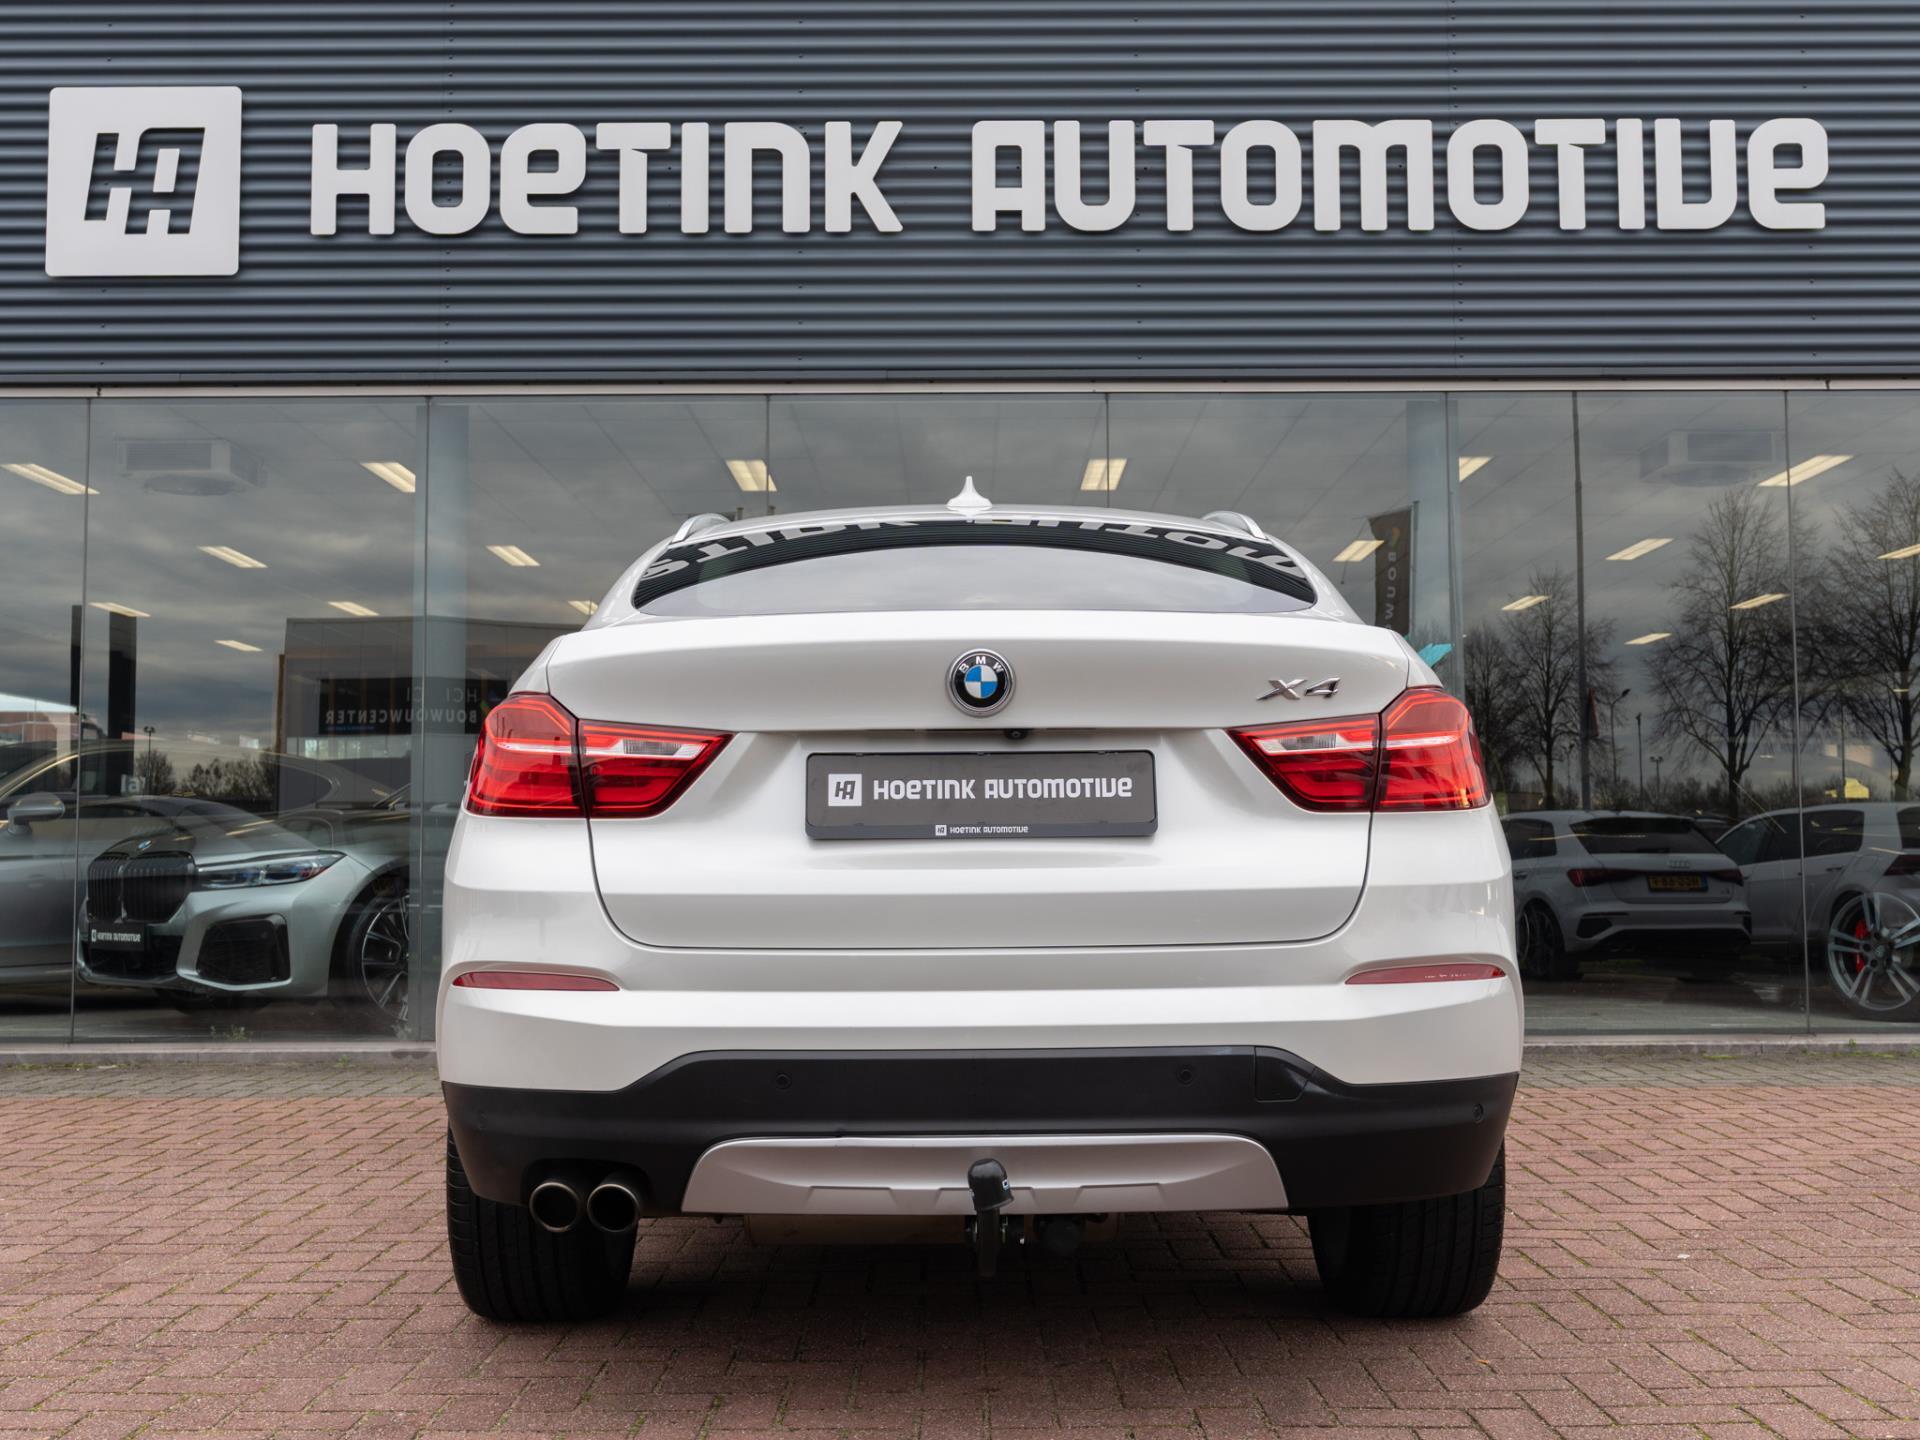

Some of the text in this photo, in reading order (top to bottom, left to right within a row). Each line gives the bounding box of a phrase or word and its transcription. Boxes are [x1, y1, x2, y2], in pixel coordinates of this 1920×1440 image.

[310, 118, 1829, 236] HOETINK AUTOMOTIVE
[959, 656, 1003, 674] BMW
[1256, 677, 1341, 701] X4
[873, 779, 976, 800] HOETINK
[984, 777, 1133, 799] AUTOMOTIVE
[983, 825, 1029, 833] AUTOMOTIVE
